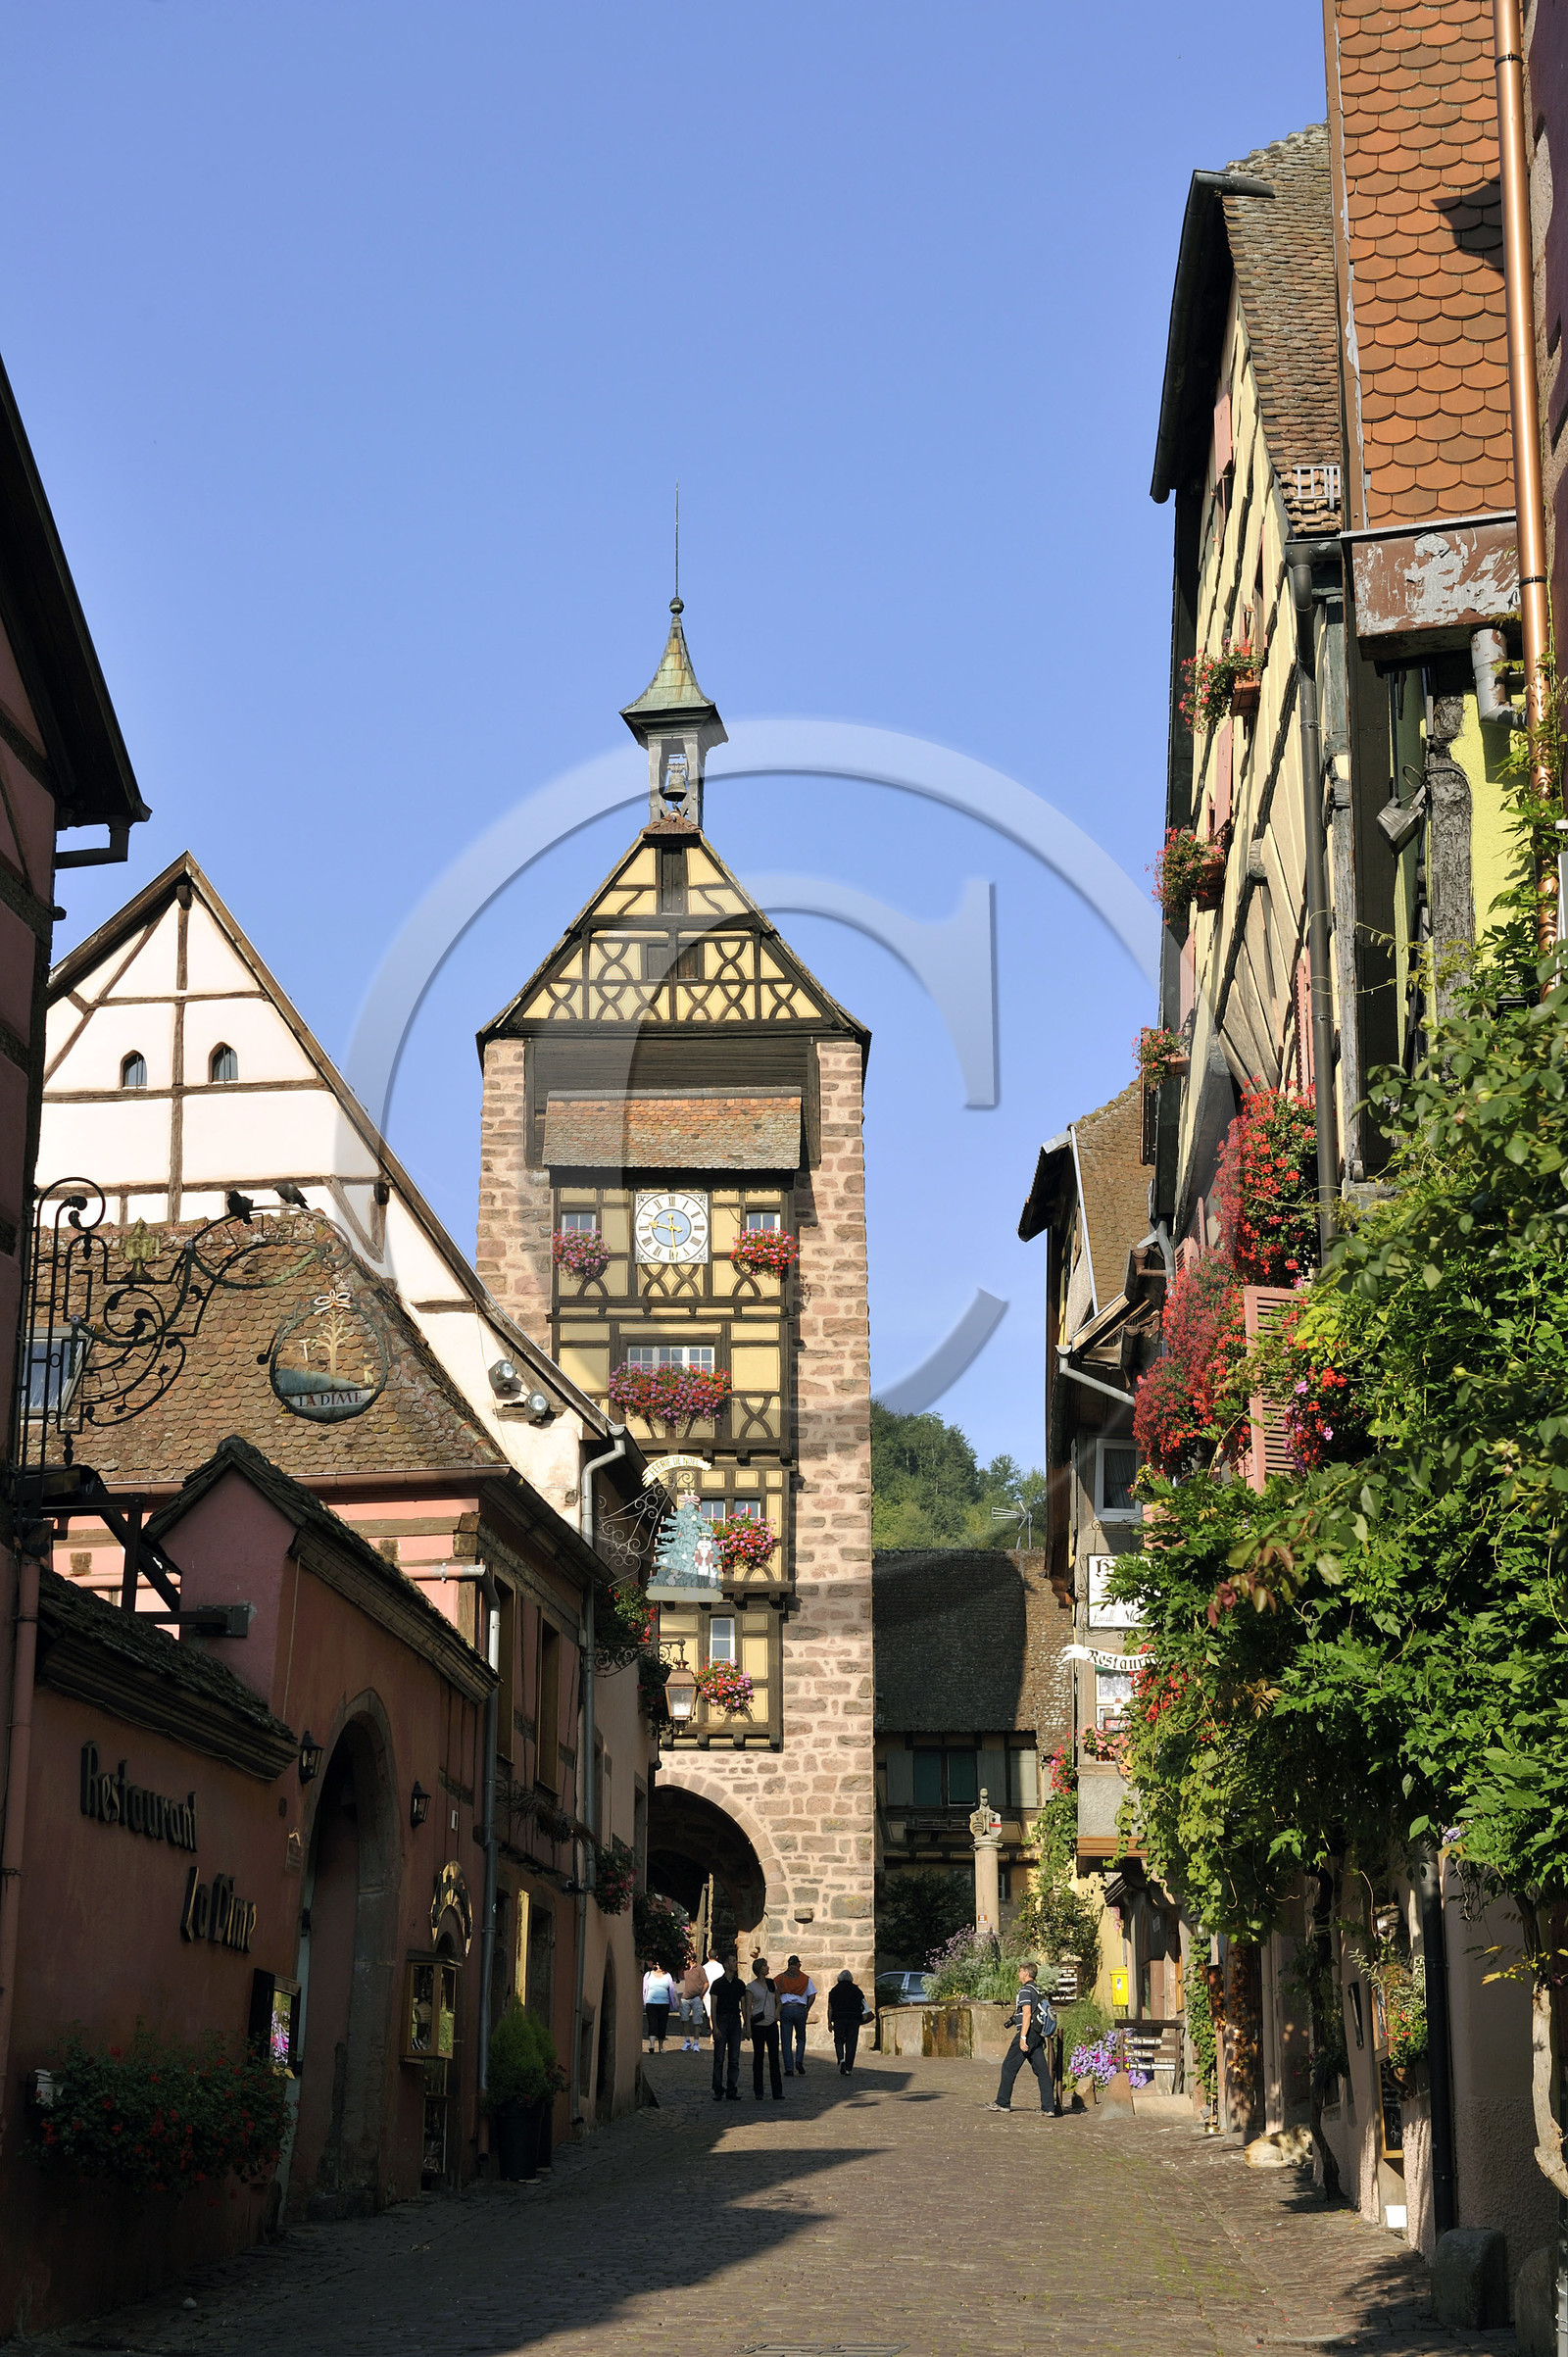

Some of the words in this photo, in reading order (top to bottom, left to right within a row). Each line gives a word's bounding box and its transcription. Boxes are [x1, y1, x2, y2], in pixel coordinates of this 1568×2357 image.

[298, 1395, 317, 1406] LA
[672, 1456, 681, 1466] DE
[80, 1740, 198, 1853] Restaurant
